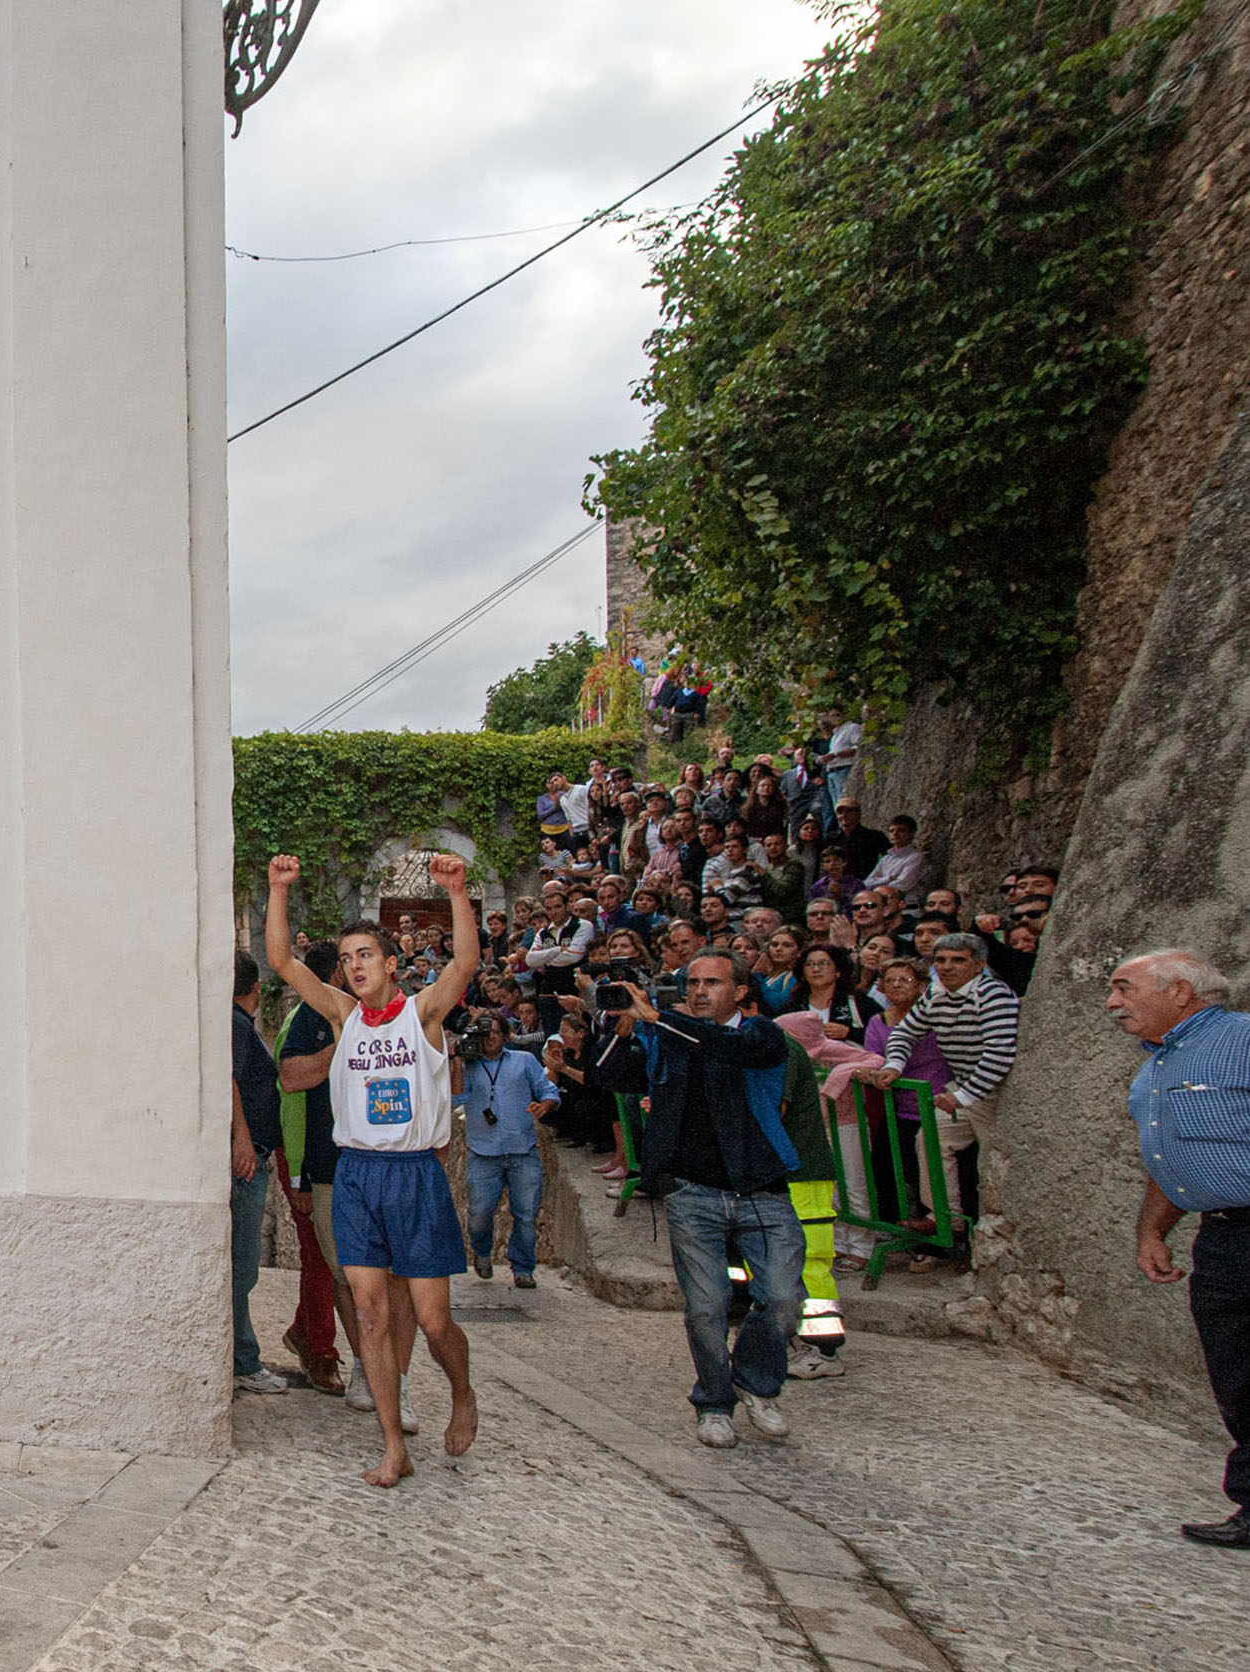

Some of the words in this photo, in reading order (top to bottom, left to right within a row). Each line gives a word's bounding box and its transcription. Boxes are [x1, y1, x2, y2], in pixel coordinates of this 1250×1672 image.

[357, 1036, 407, 1055] CORSA
[378, 1089, 399, 1098] EURO
[374, 1098, 404, 1115] Spin
